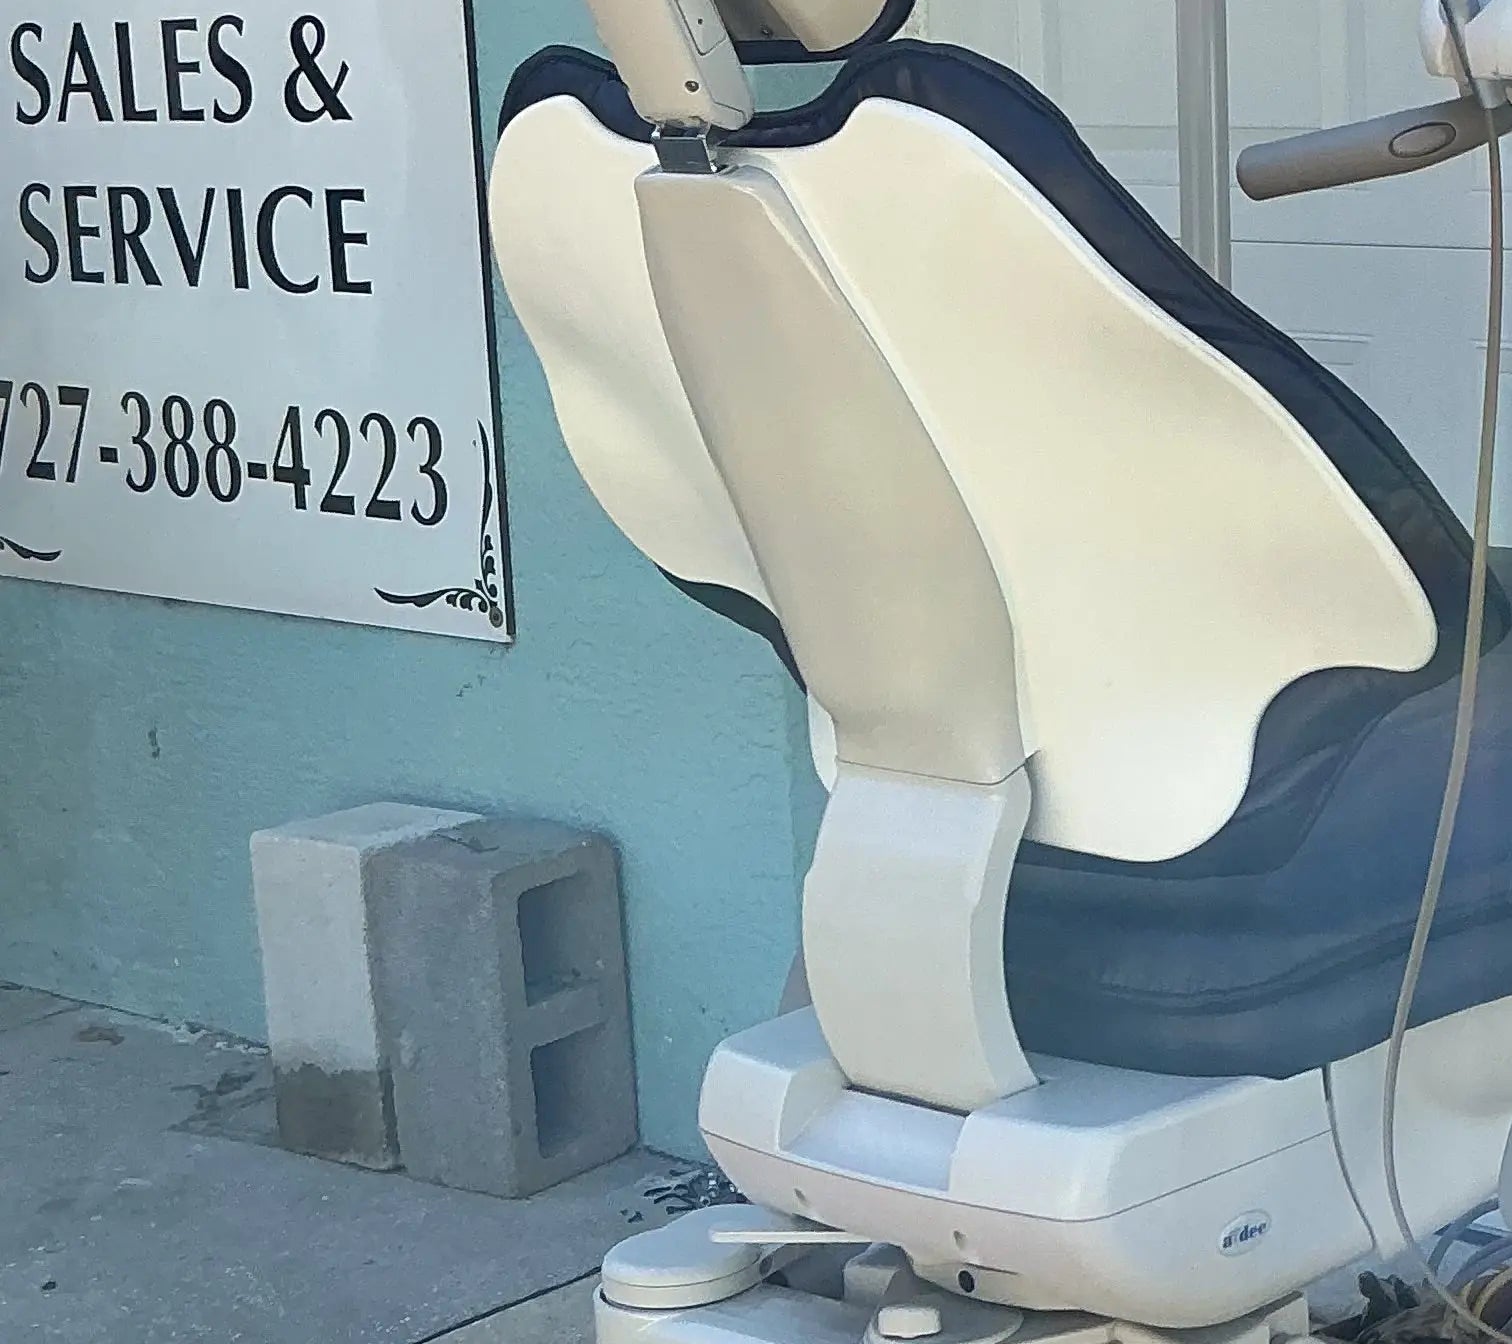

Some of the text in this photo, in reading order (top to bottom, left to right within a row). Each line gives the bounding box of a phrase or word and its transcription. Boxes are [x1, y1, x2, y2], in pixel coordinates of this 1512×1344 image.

[10, 14, 353, 125] SALES &
[19, 182, 373, 295] SERVICE
